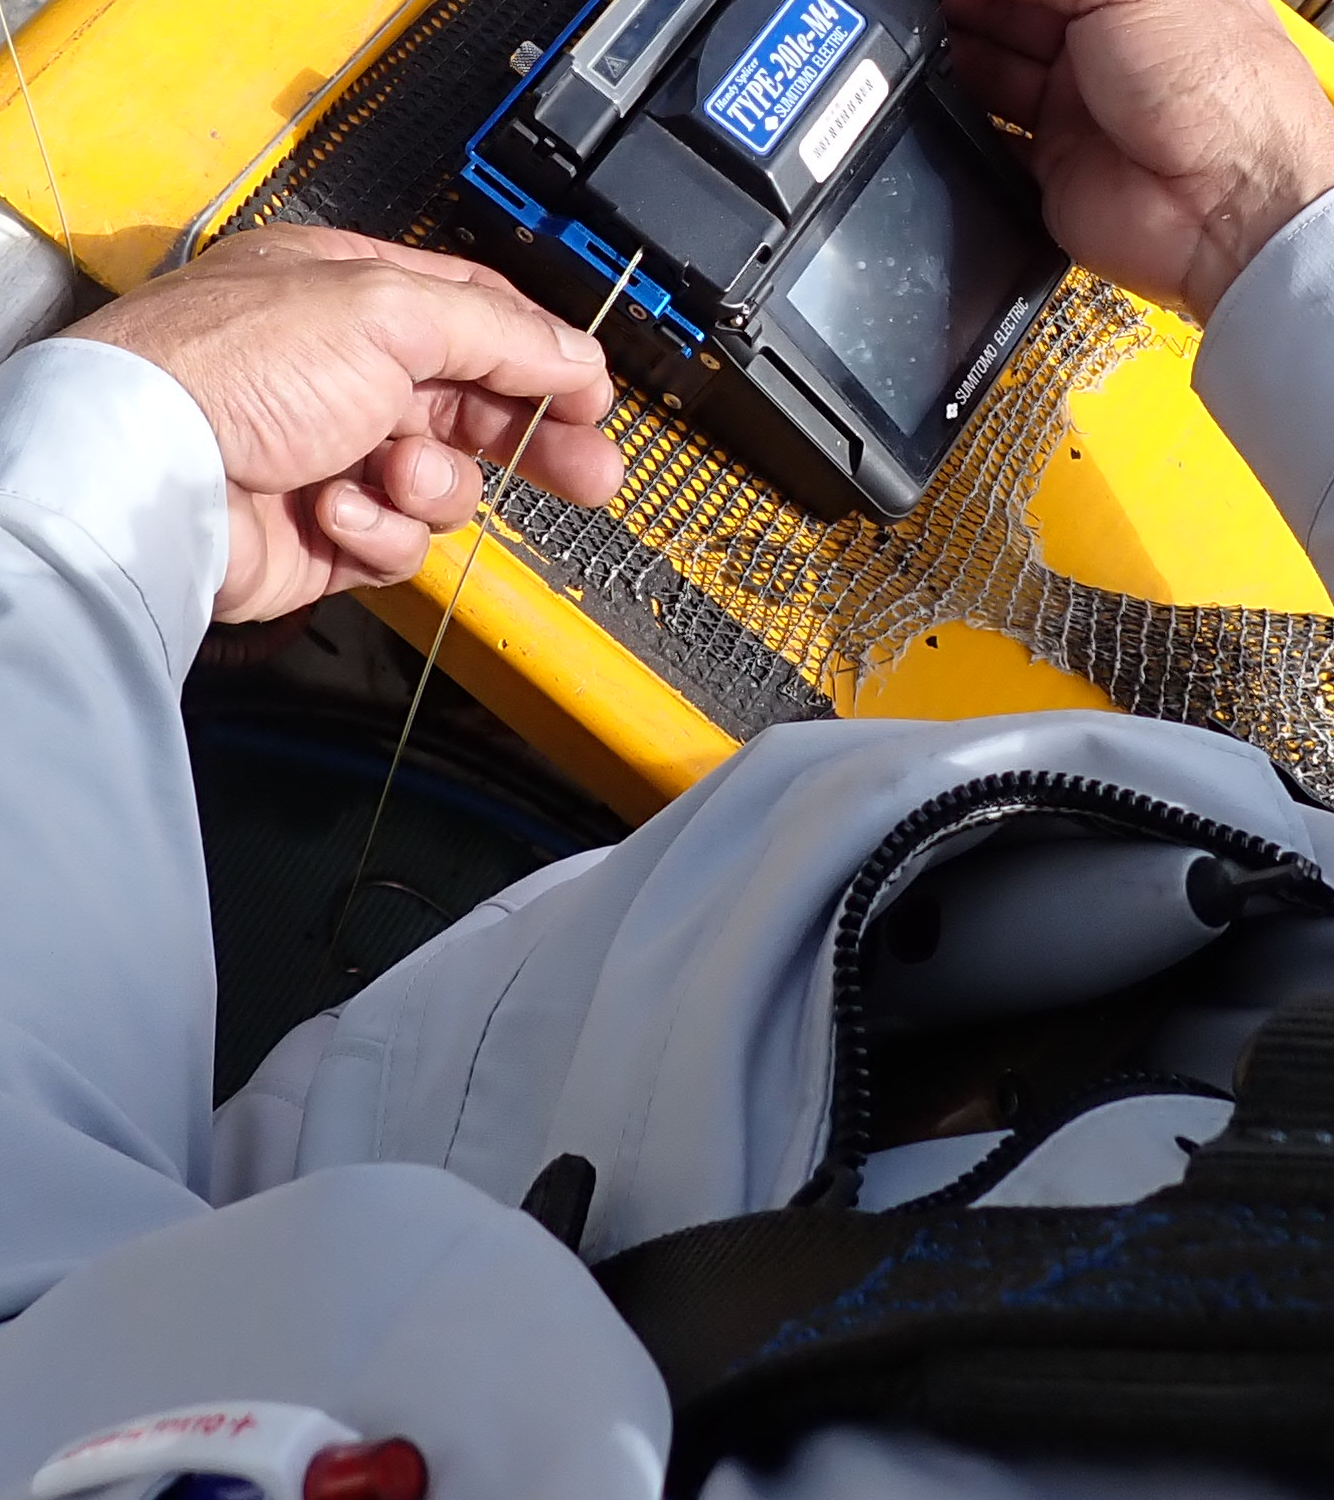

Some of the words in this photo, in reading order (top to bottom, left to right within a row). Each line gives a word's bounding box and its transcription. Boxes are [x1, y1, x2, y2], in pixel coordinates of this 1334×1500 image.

[716, 84, 740, 111] Handy
[734, 57, 760, 86] Splicer
[773, 65, 818, 118] SUMITOMO
[811, 25, 848, 69] ELECTRIC
[955, 343, 998, 405] SUMITOMO
[993, 296, 1029, 347] ELECTRIC
